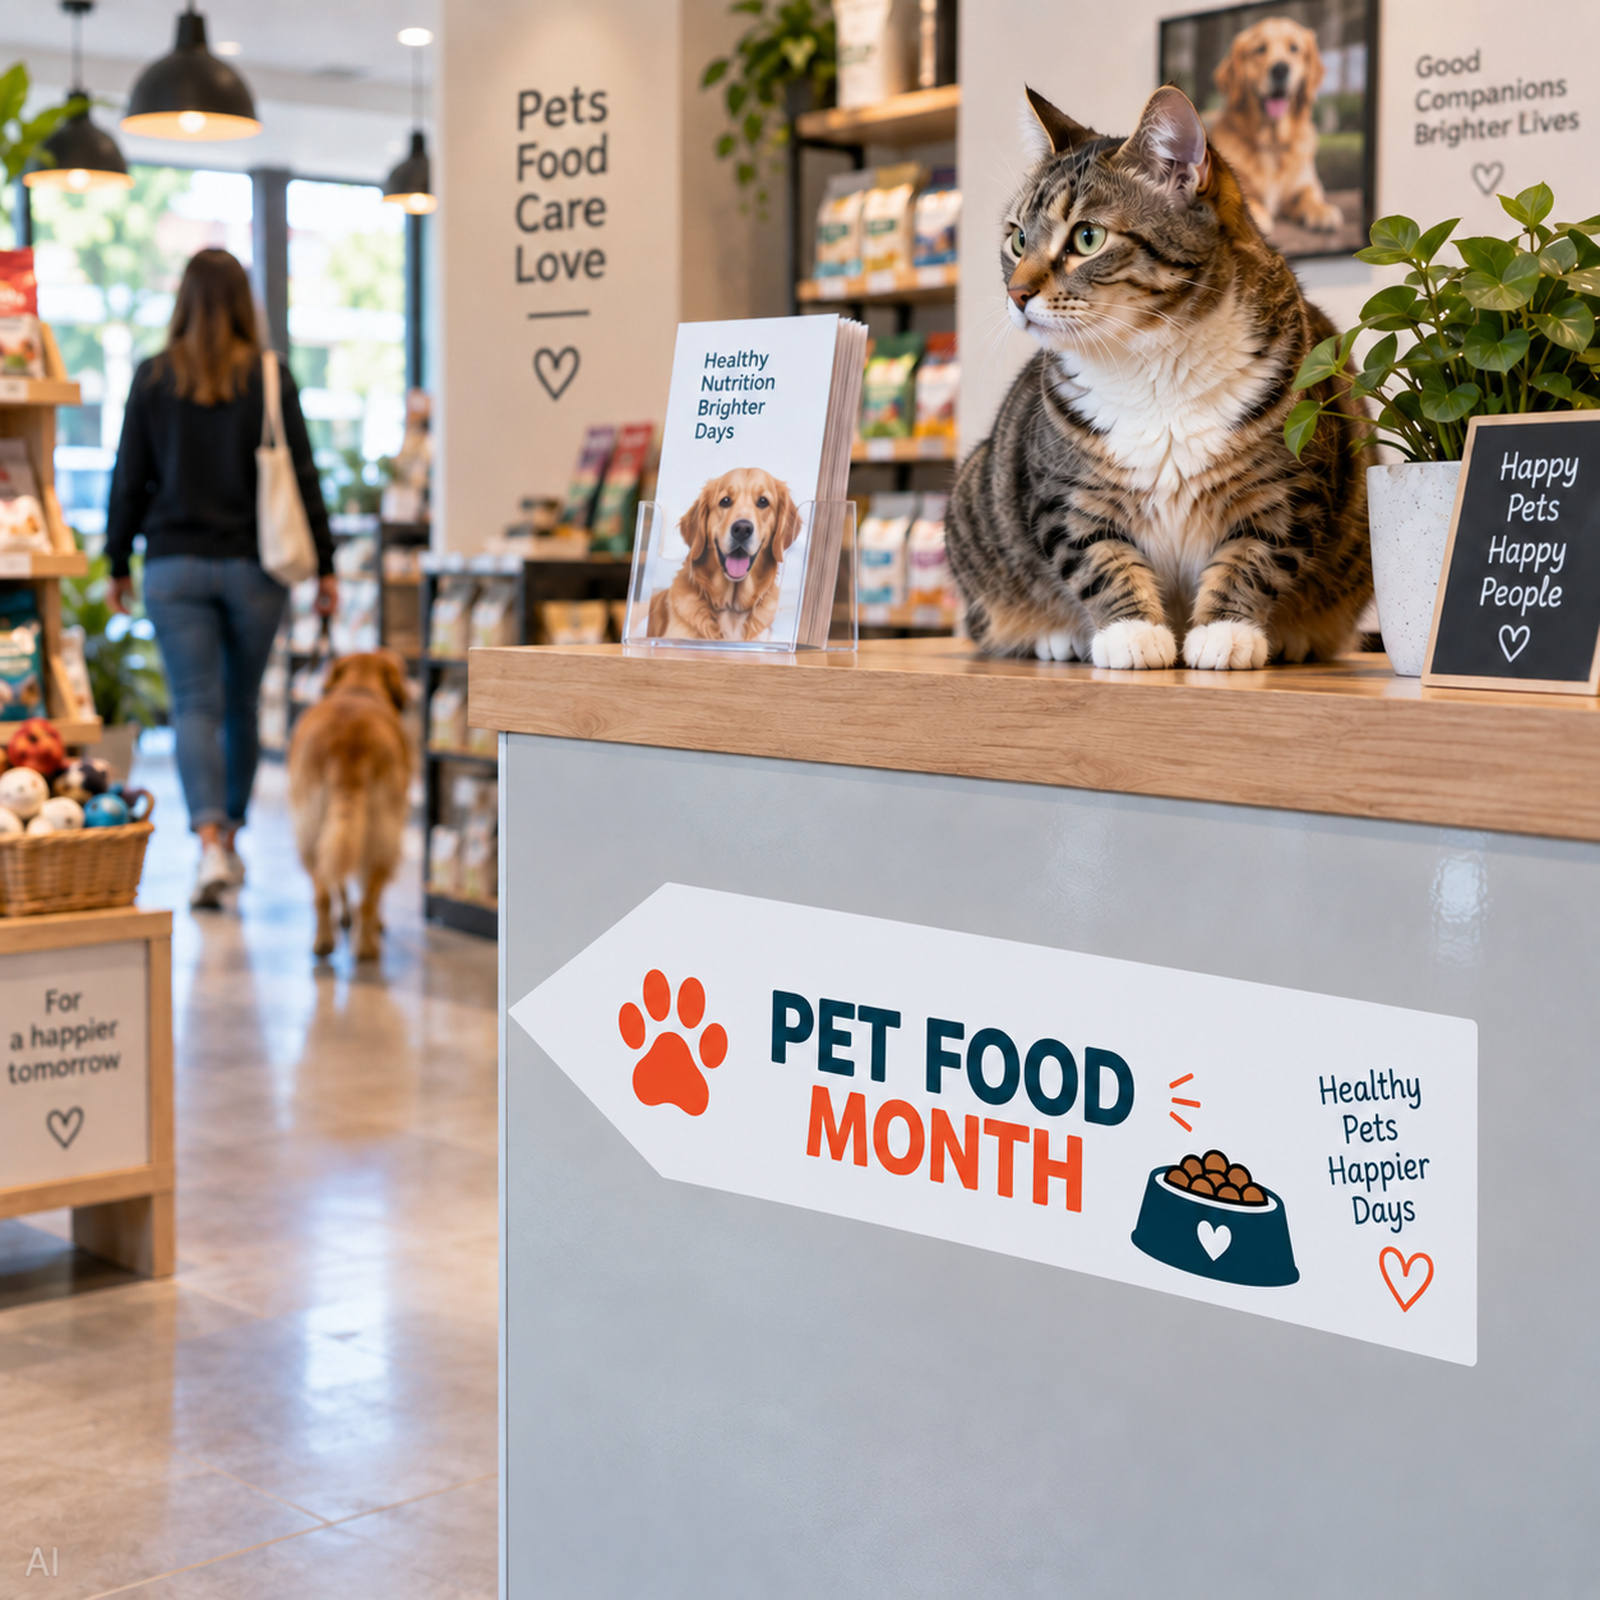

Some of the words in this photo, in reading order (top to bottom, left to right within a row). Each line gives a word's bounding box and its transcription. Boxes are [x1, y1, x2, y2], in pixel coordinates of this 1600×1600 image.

[1415, 48, 1481, 79] Good
[517, 85, 608, 132] Pets
[1415, 78, 1568, 113] Companions
[1414, 116, 1513, 149] Brighter
[1518, 110, 1580, 135] Lives
[517, 132, 608, 183] Food
[515, 193, 607, 234] Care
[515, 245, 606, 284] Love
[704, 349, 770, 372] Healthy
[701, 373, 776, 392] Nutrition
[697, 397, 766, 420] Brighter
[694, 422, 735, 444] Days
[1500, 450, 1579, 489] Happy
[1506, 492, 1560, 522] Pets
[1487, 534, 1567, 574] Happy
[1479, 574, 1563, 617] People
[45, 988, 83, 1014] For
[9, 1032, 24, 1052] a
[30, 1016, 119, 1052] happier
[7, 1051, 122, 1085] tomorrow
[771, 989, 902, 1083] PET
[925, 1016, 1135, 1127] FOOD
[1318, 1067, 1422, 1110] Healthy
[1342, 1113, 1399, 1144] Pets
[806, 1084, 1083, 1213] MONTH
[1328, 1151, 1430, 1193] Happier
[1351, 1195, 1416, 1233] Days
